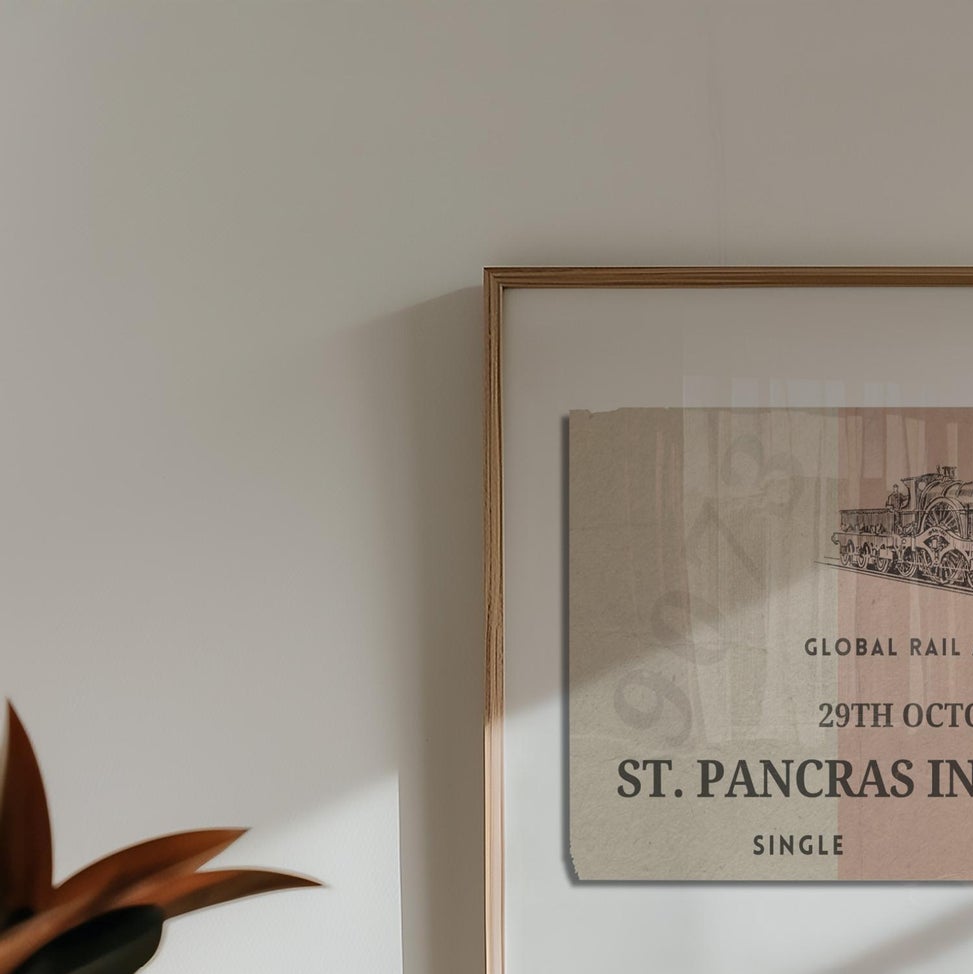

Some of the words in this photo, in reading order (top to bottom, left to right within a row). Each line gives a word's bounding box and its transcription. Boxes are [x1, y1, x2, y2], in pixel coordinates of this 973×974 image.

[804, 637, 898, 657] GLOBAL
[910, 637, 961, 657] RAIL
[818, 702, 894, 728] 29TH
[617, 758, 683, 799] ST.
[696, 758, 915, 799] PANCRAS
[752, 834, 844, 856] SINGLE
